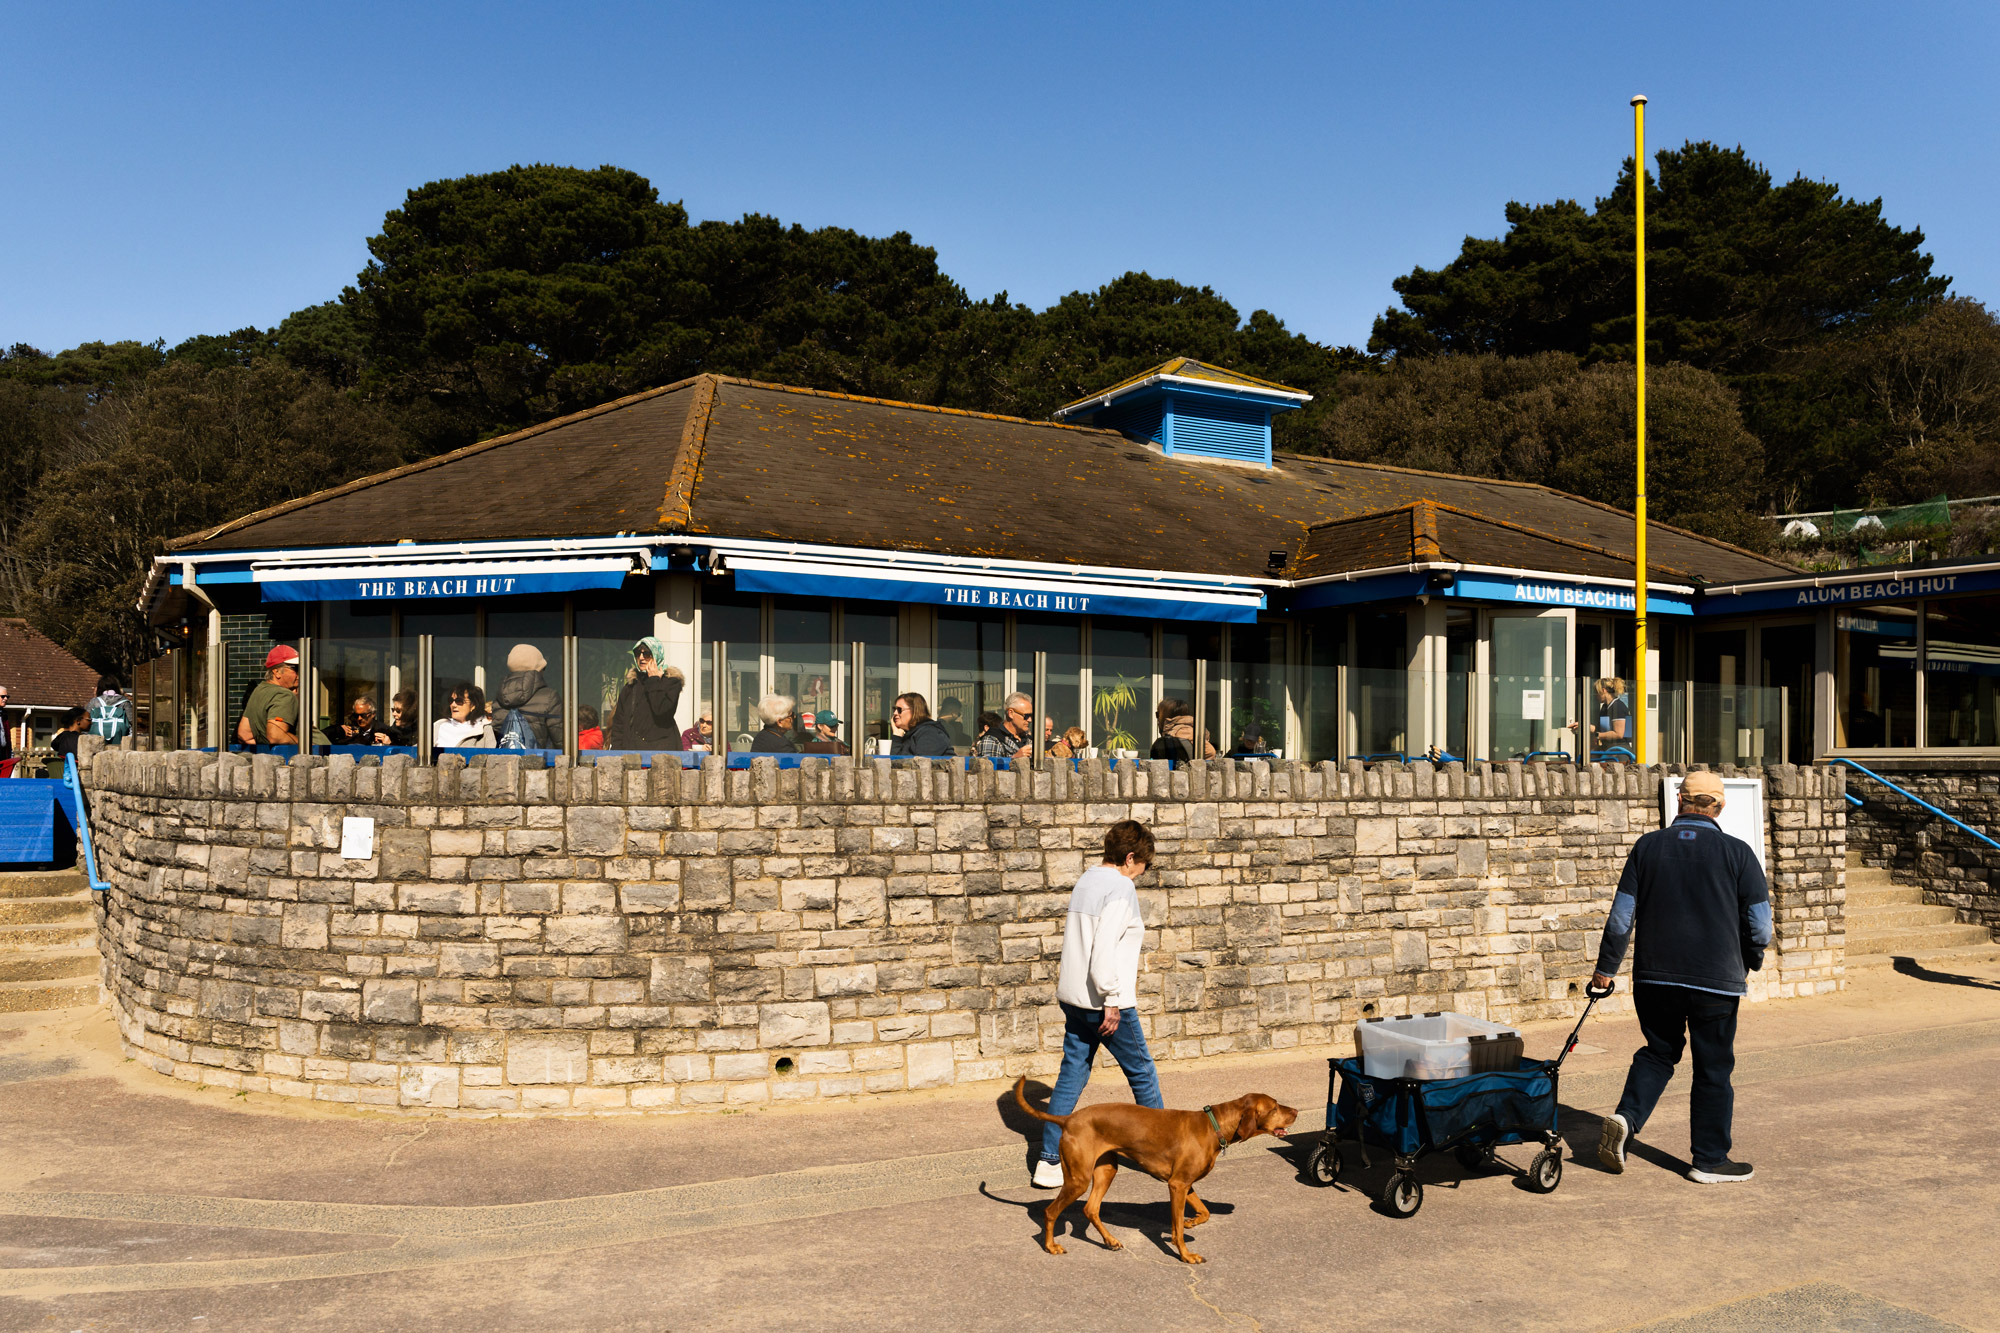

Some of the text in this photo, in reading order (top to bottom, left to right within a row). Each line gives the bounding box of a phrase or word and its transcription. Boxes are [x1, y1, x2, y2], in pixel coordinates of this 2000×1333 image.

[359, 578, 515, 597] THE BEACH HUT
[1514, 583, 1560, 603] ALUM
[1563, 587, 1616, 607] BEACH
[1797, 576, 1957, 604] ALUM BEACH HUT
[944, 588, 1090, 611] THE BEACH HUT
